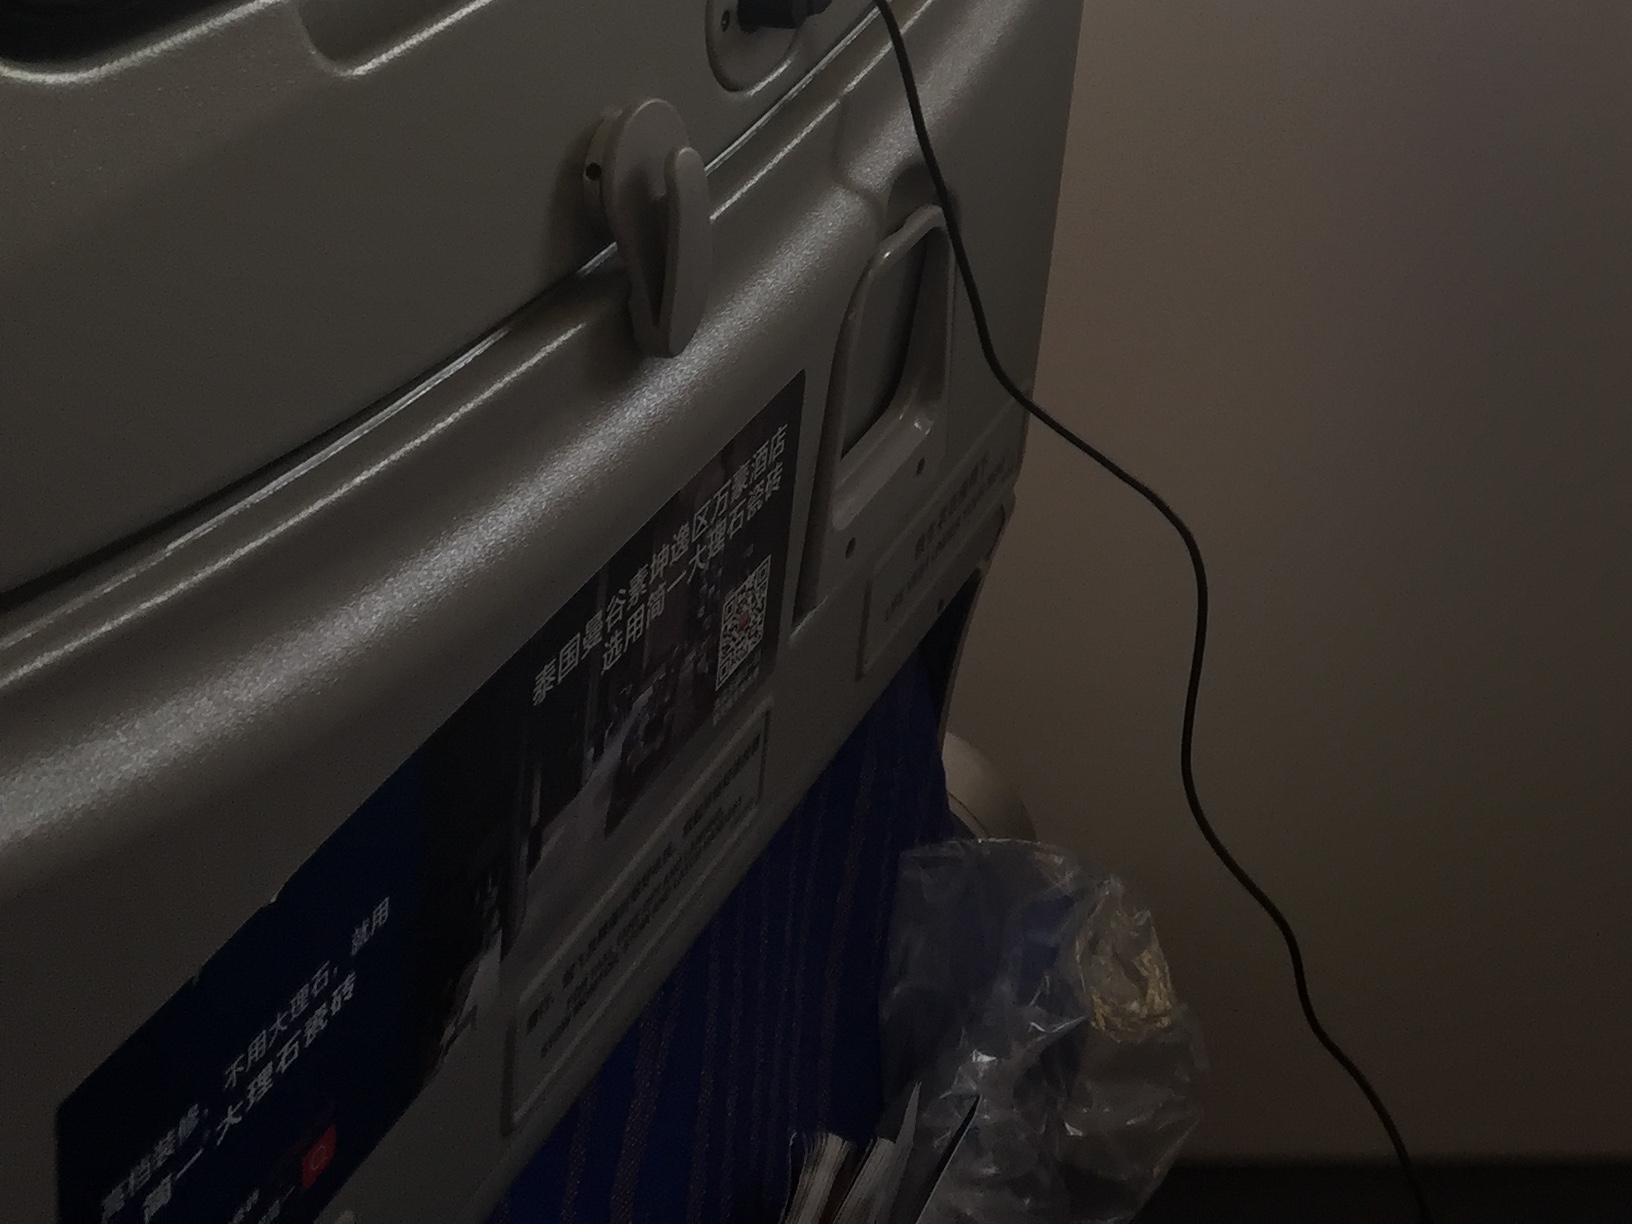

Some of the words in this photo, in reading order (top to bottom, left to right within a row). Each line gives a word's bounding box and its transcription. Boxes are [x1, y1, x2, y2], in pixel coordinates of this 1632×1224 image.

[533, 423, 788, 705] 泰国曼谷素坤逸区万豪酒店
[602, 463, 782, 674] 选用简一大理石瓷砖
